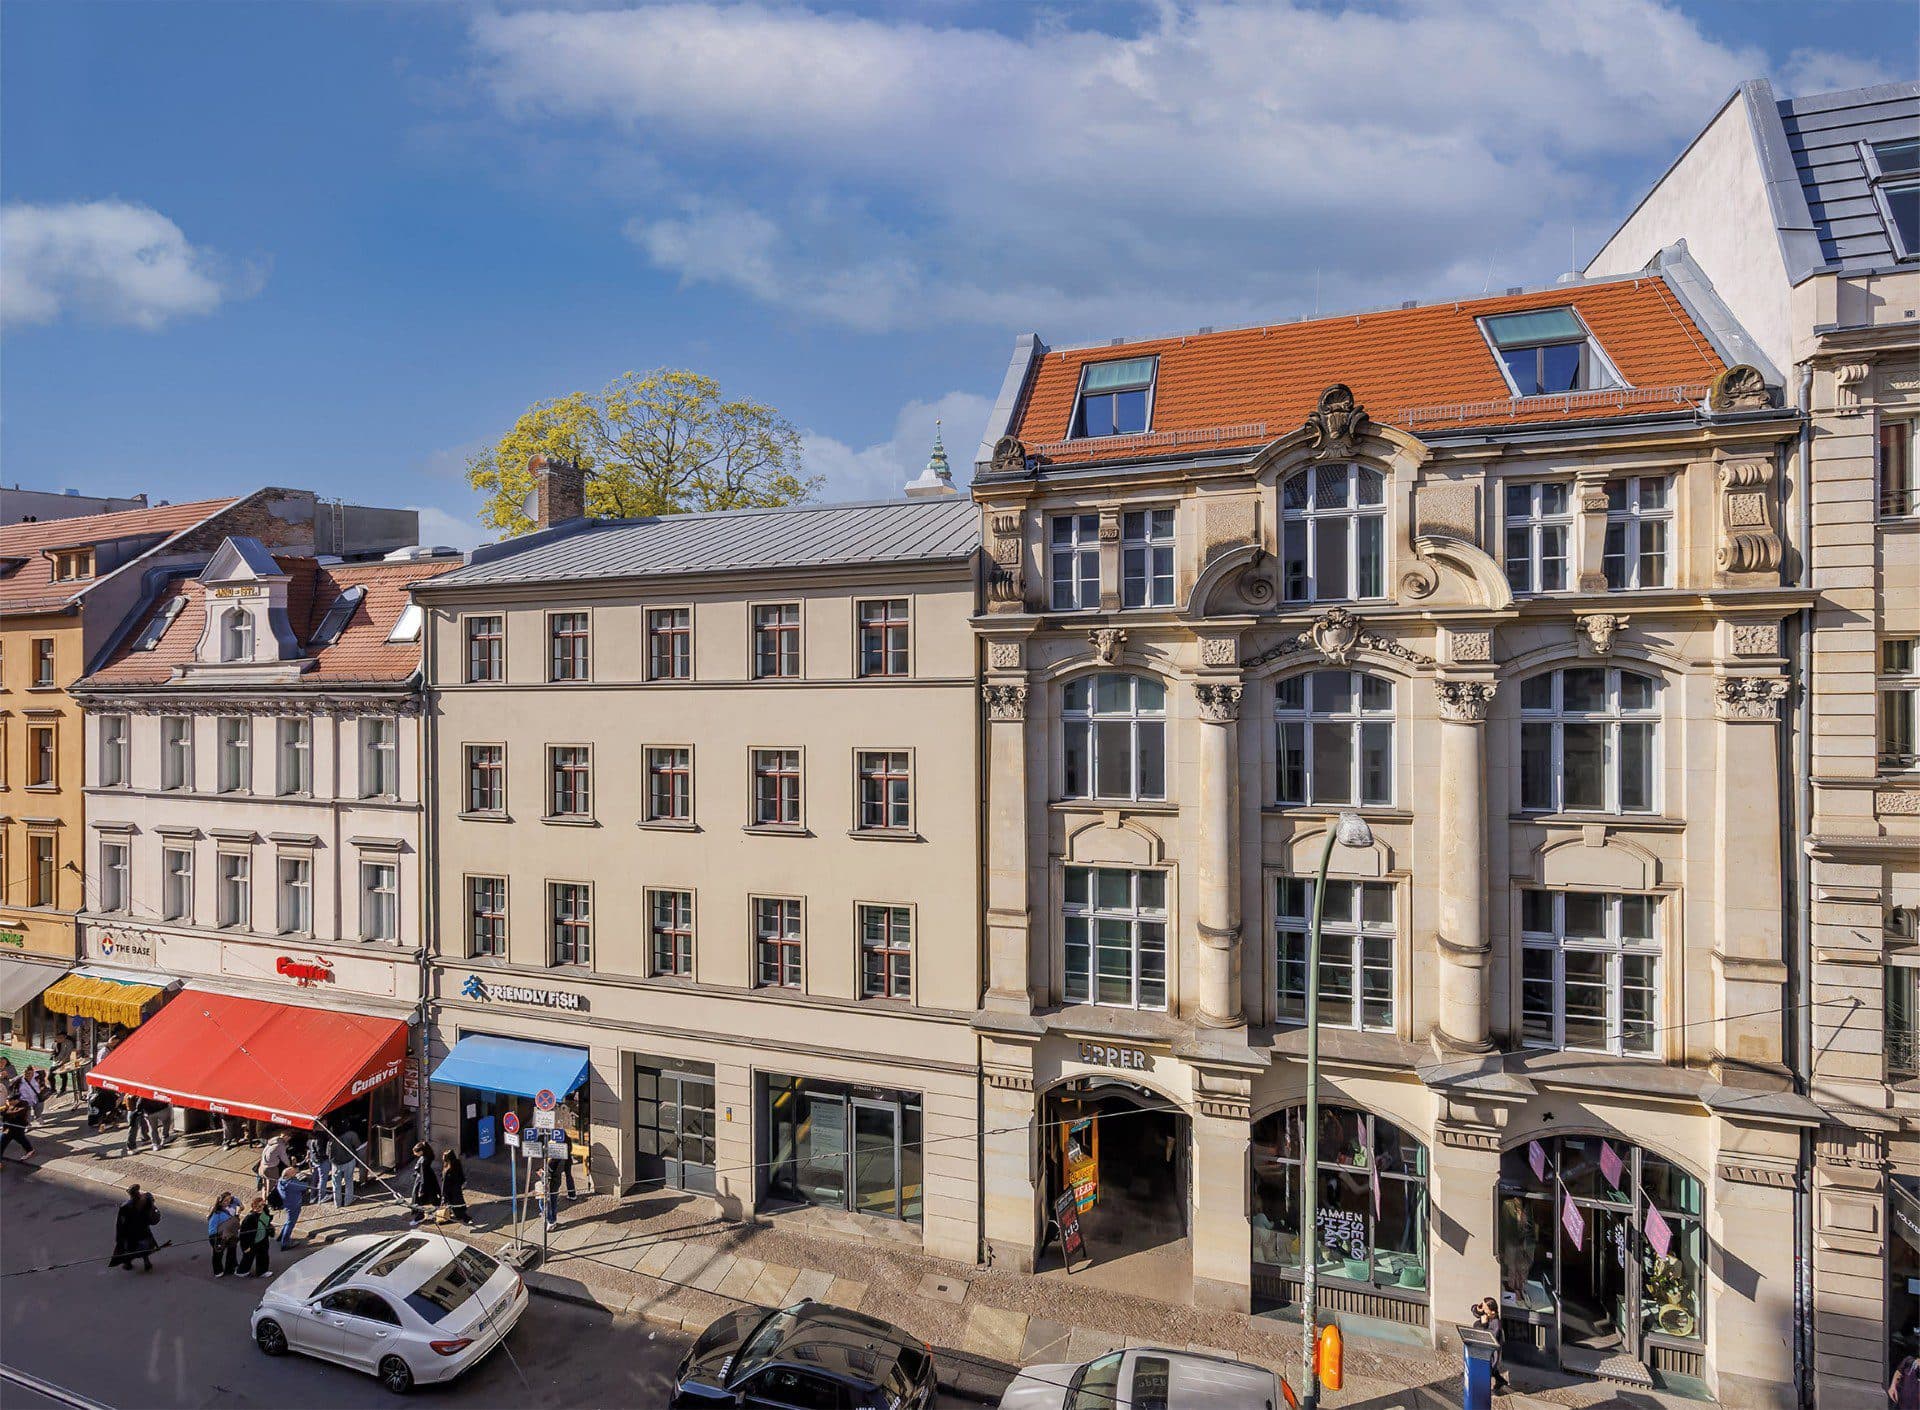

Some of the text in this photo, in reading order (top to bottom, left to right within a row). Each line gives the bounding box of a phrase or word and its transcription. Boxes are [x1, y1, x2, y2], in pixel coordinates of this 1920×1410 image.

[116, 944, 151, 956] THE BASE
[1078, 1042, 1145, 1068] UPPER
